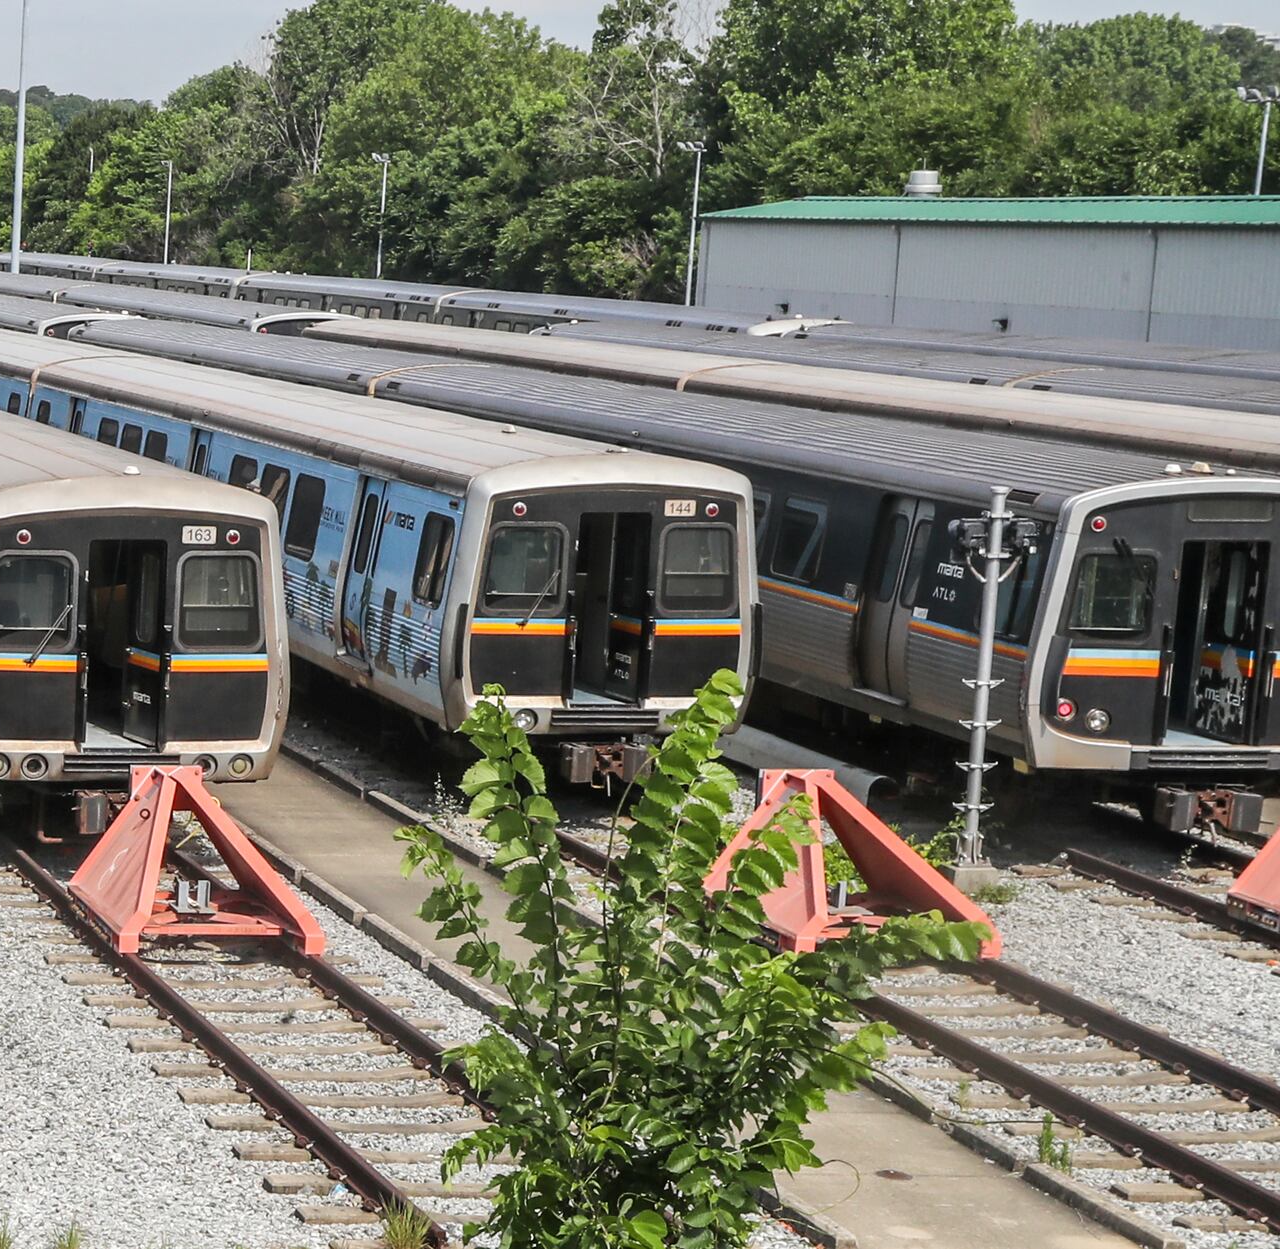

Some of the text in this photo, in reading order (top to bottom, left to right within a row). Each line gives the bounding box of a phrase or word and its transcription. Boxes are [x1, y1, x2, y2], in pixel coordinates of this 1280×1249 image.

[668, 502, 691, 515] 144
[187, 529, 212, 542] 163
[937, 562, 965, 579] marta
